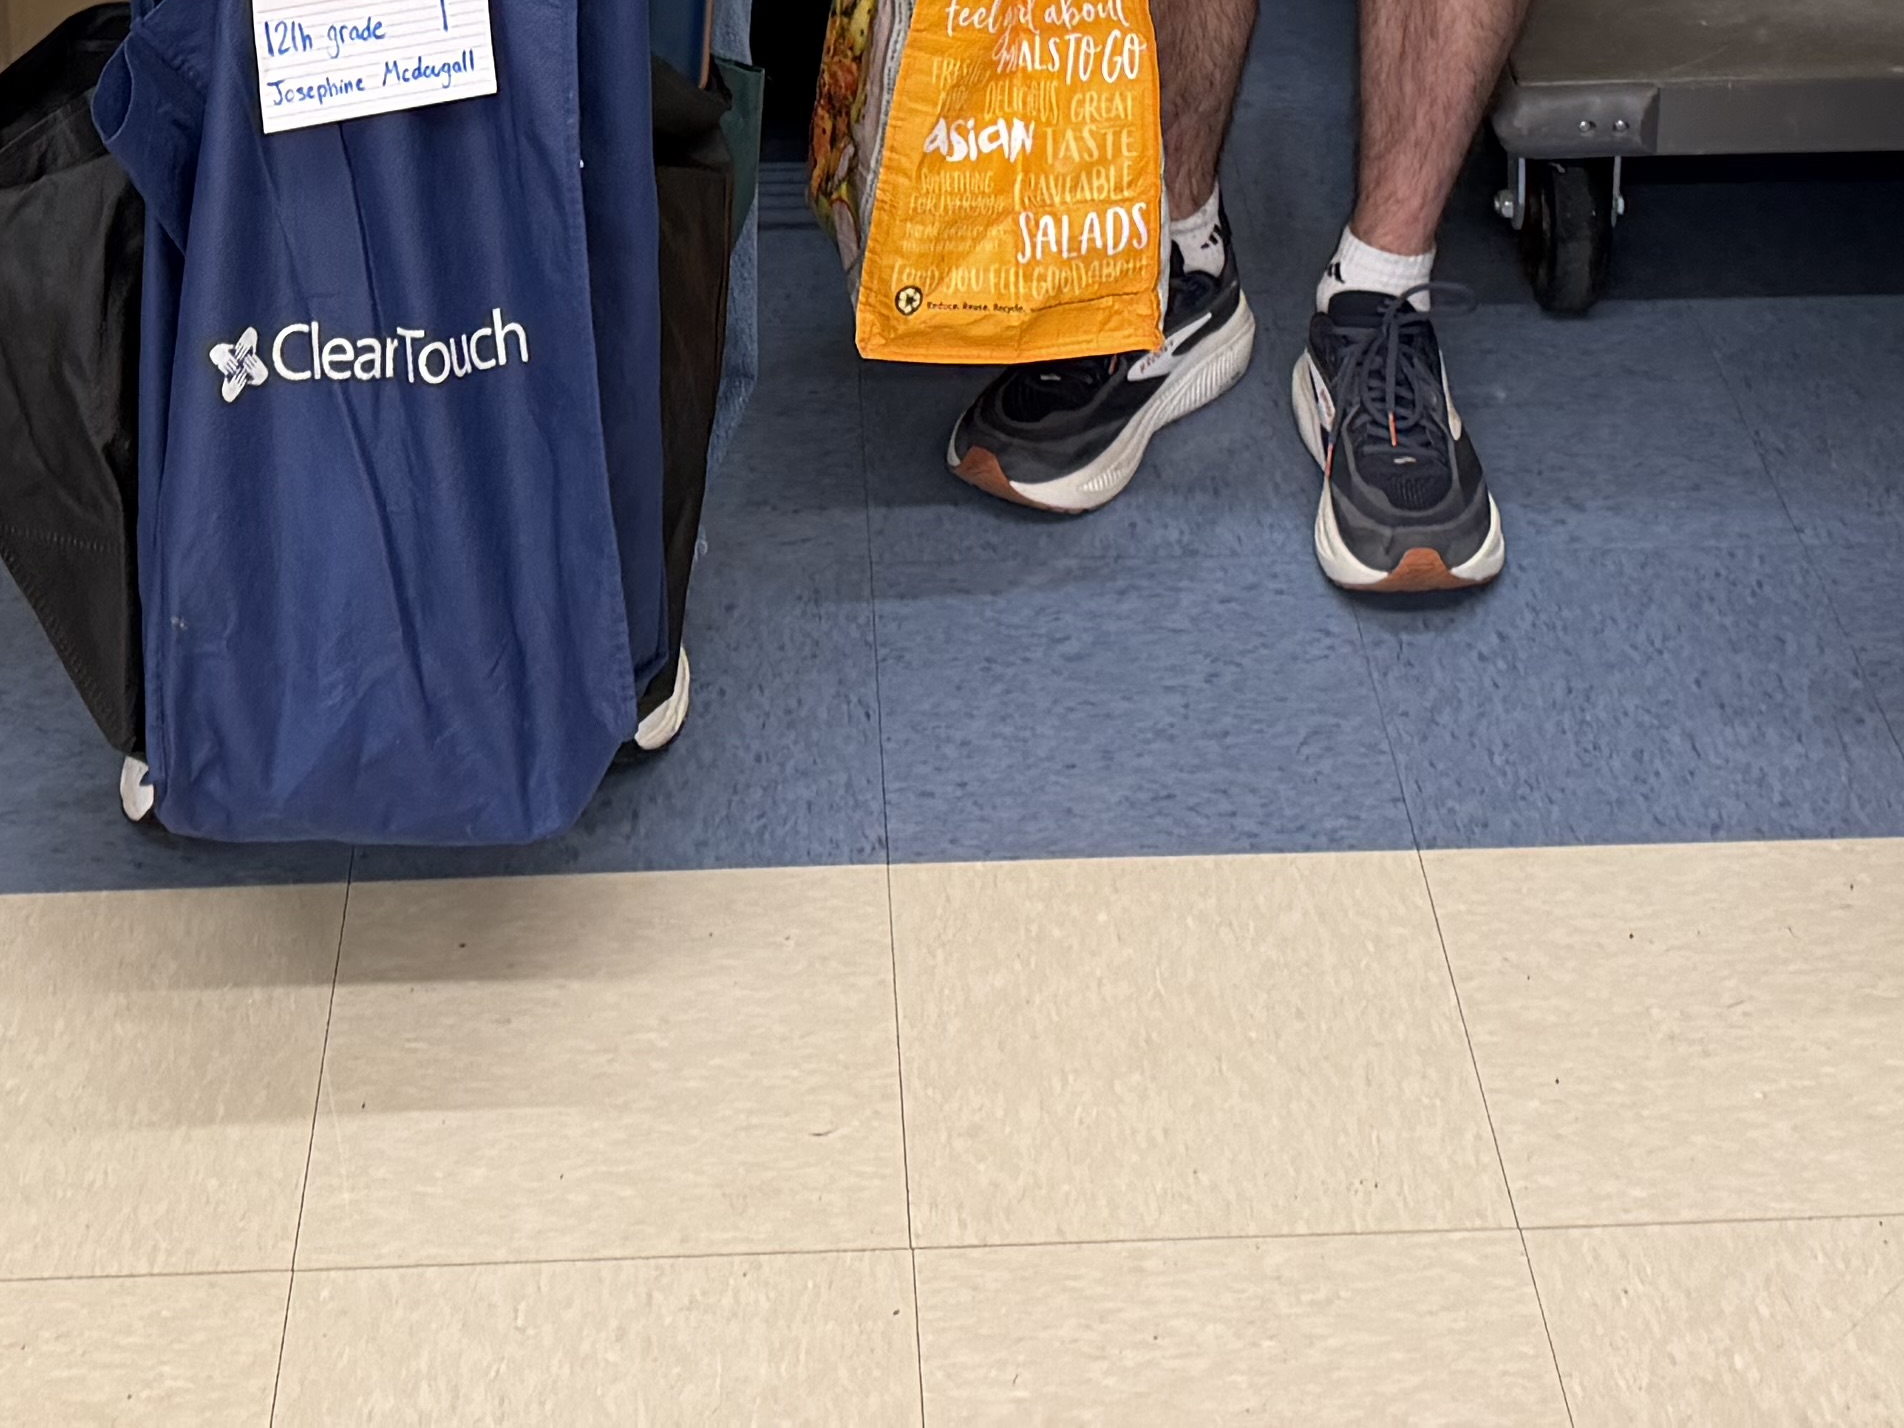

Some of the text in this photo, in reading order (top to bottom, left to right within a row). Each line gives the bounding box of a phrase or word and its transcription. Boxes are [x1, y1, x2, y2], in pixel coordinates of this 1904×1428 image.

[326, 17, 386, 60] grade
[1065, 28, 1147, 85] TO GO
[265, 75, 366, 108] Josephine
[984, 79, 1059, 123] DELICIOUS
[1071, 91, 1135, 124] GREAT
[1045, 126, 1140, 165] TASTE
[921, 170, 994, 194] SOMETHING
[1013, 158, 1134, 212] CRAVEABLE
[1016, 201, 1149, 264] SALADS
[945, 264, 984, 295] YOU
[1031, 260, 1086, 301] GOOD
[271, 308, 529, 385] ClearTouch
